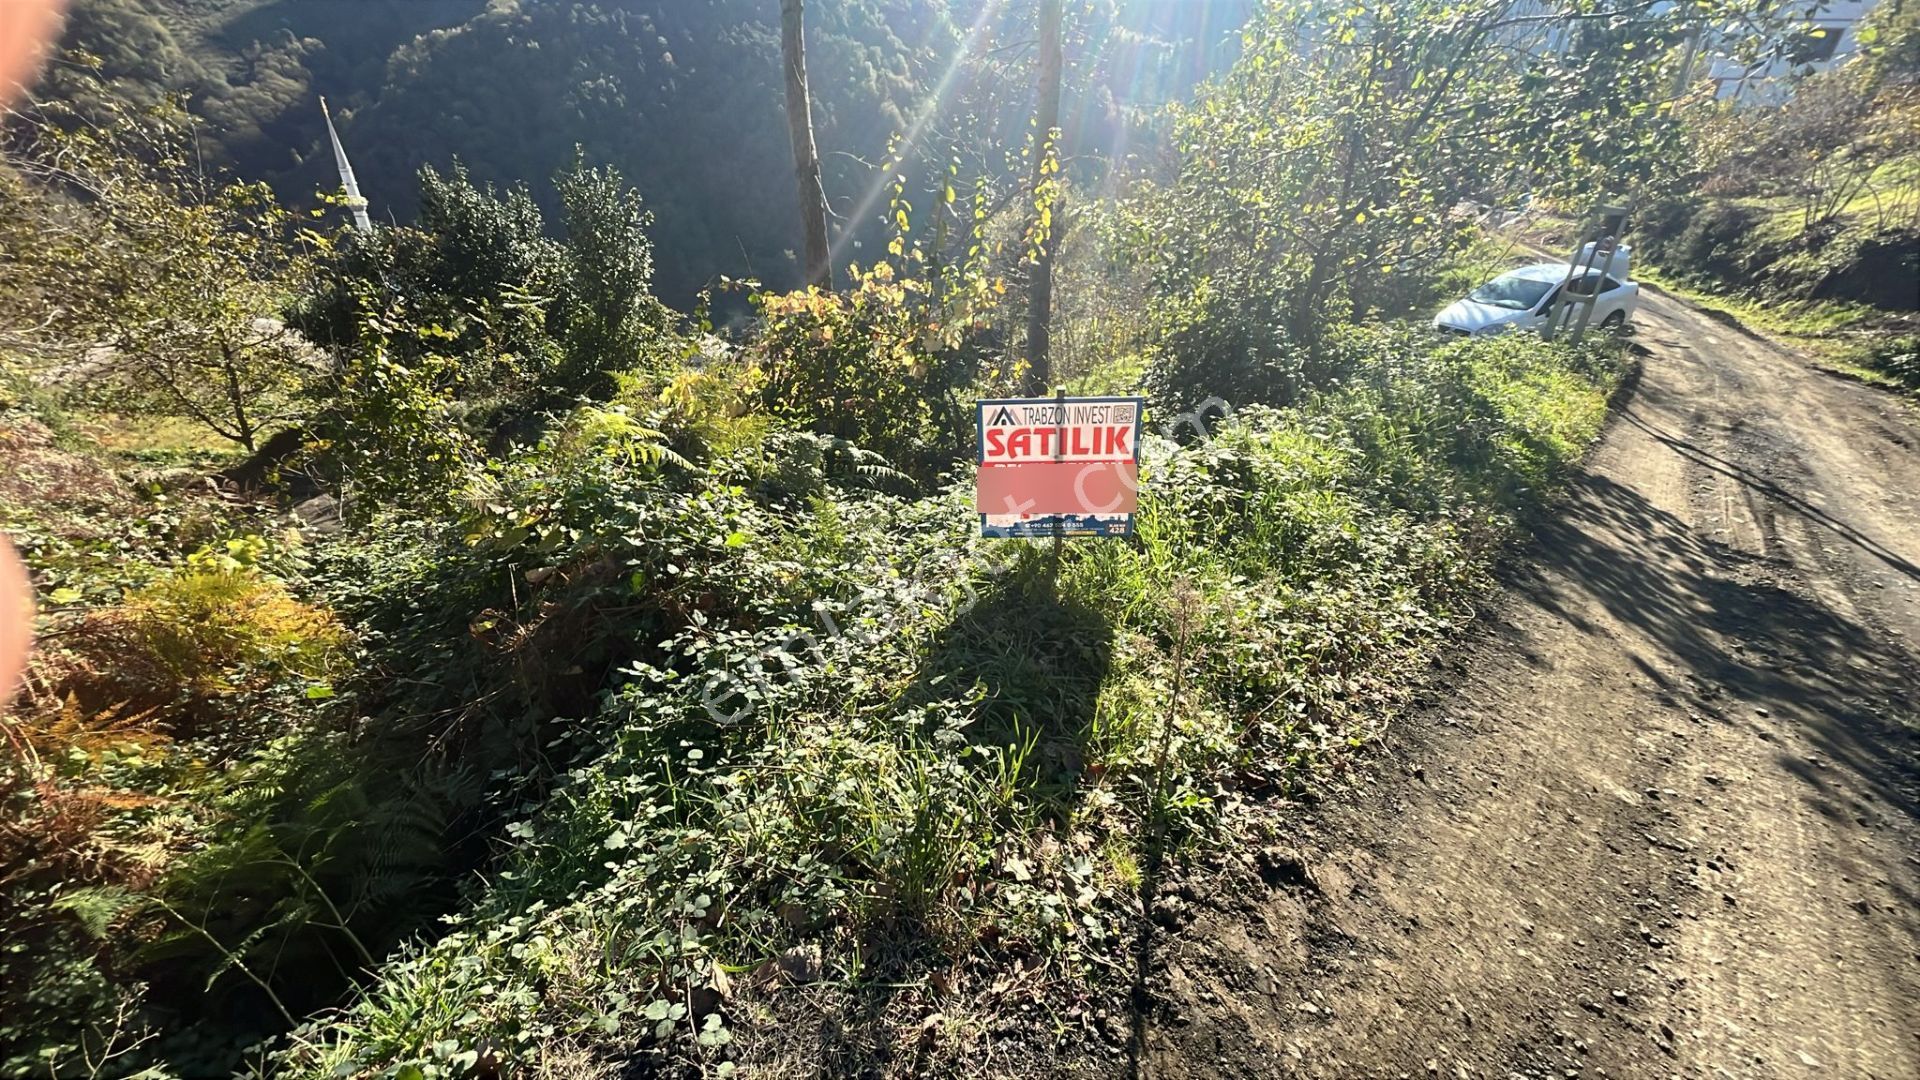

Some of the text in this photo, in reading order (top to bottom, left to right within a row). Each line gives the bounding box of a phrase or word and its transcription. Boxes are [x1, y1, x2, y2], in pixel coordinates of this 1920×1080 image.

[1022, 405, 1111, 425] TRABZON INVEST
[986, 426, 1131, 459] SATILIK
